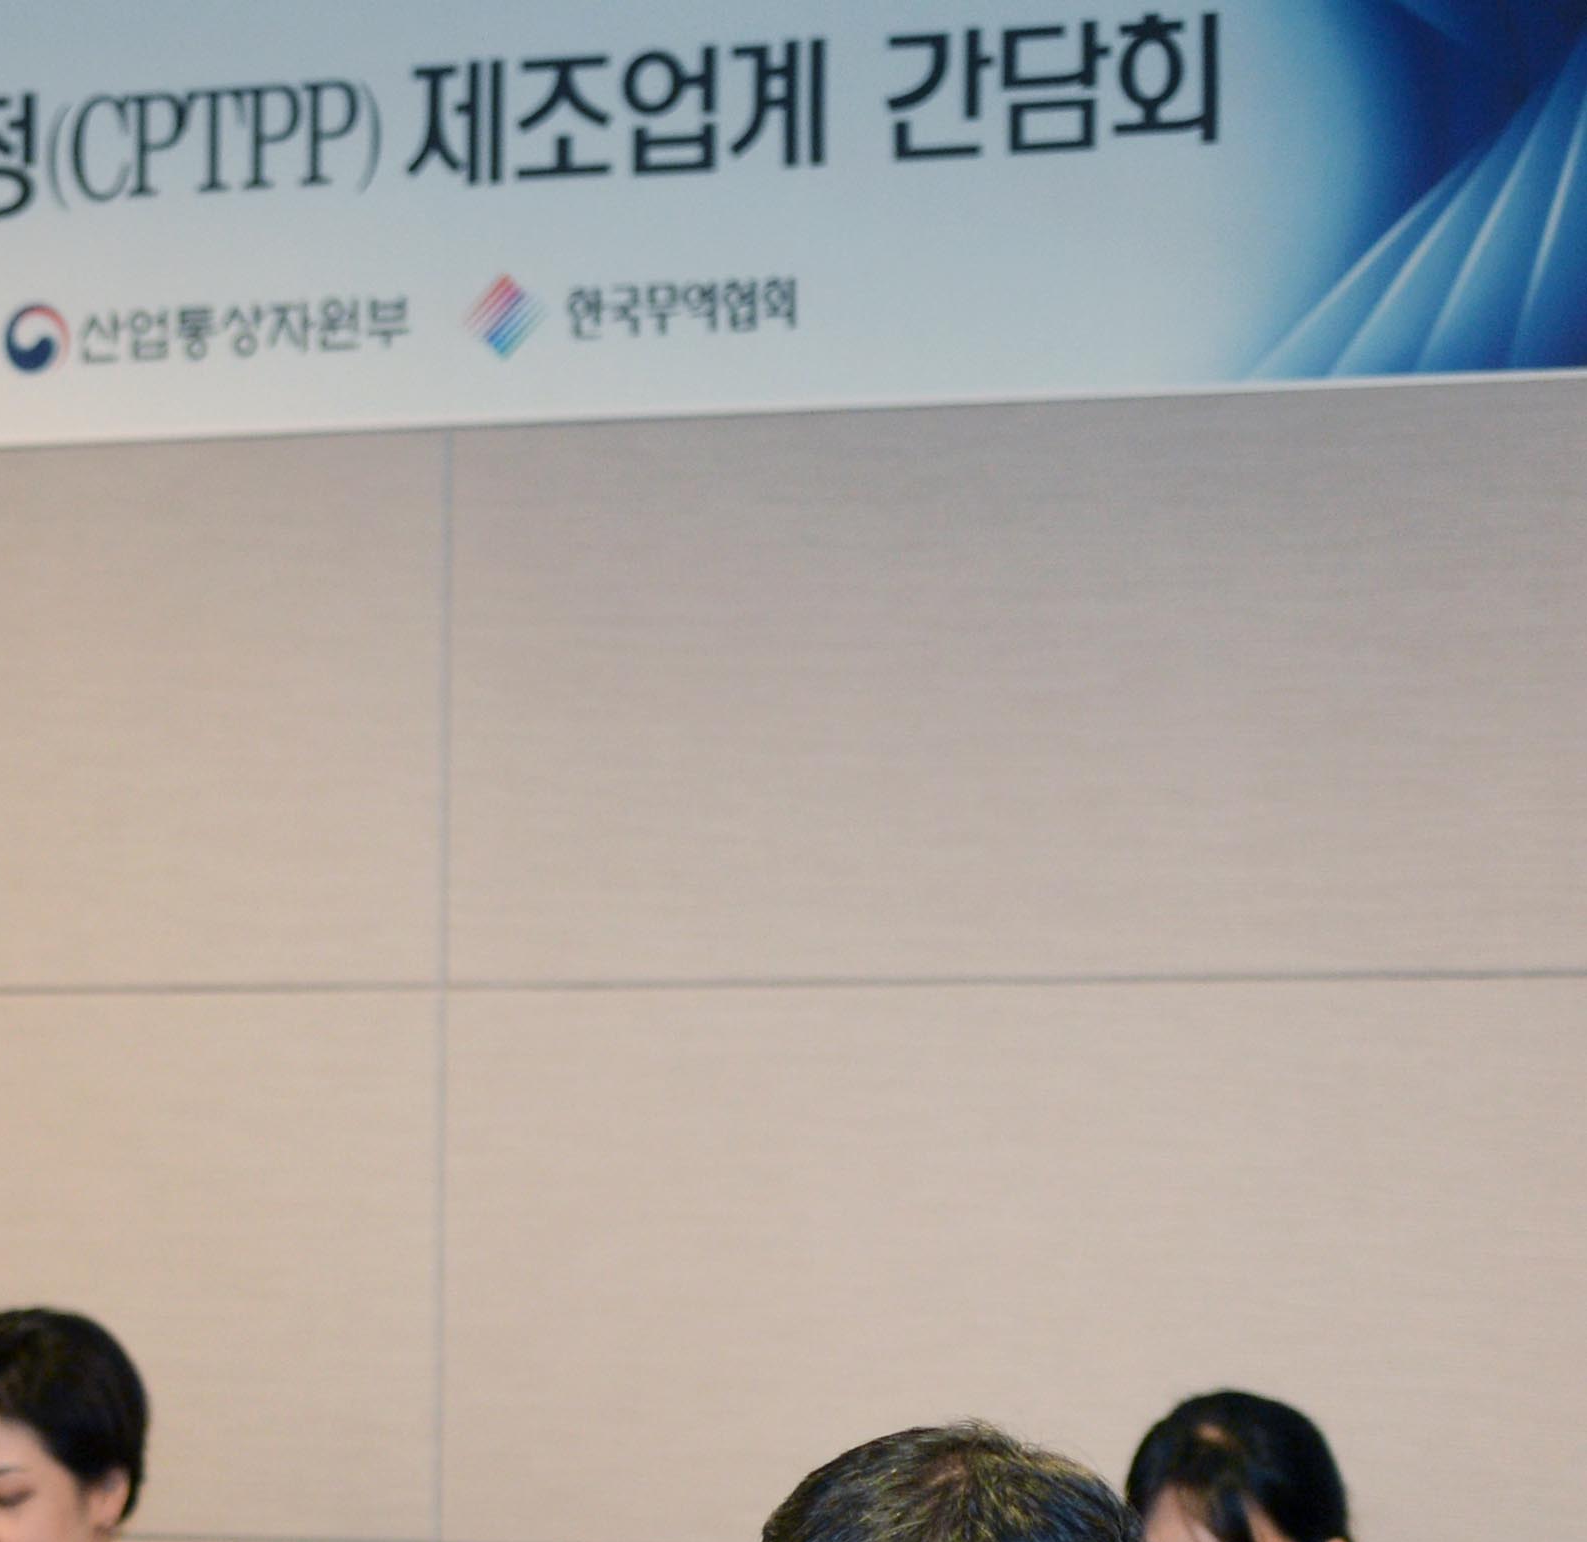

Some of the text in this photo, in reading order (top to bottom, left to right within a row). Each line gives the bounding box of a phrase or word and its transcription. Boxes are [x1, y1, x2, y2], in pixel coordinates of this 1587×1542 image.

[408, 38, 826, 185] 제조업계
[887, 12, 1219, 160] 간담회
[82, 297, 409, 364] 산업통상자원부
[567, 277, 796, 338] 한국무역협회
